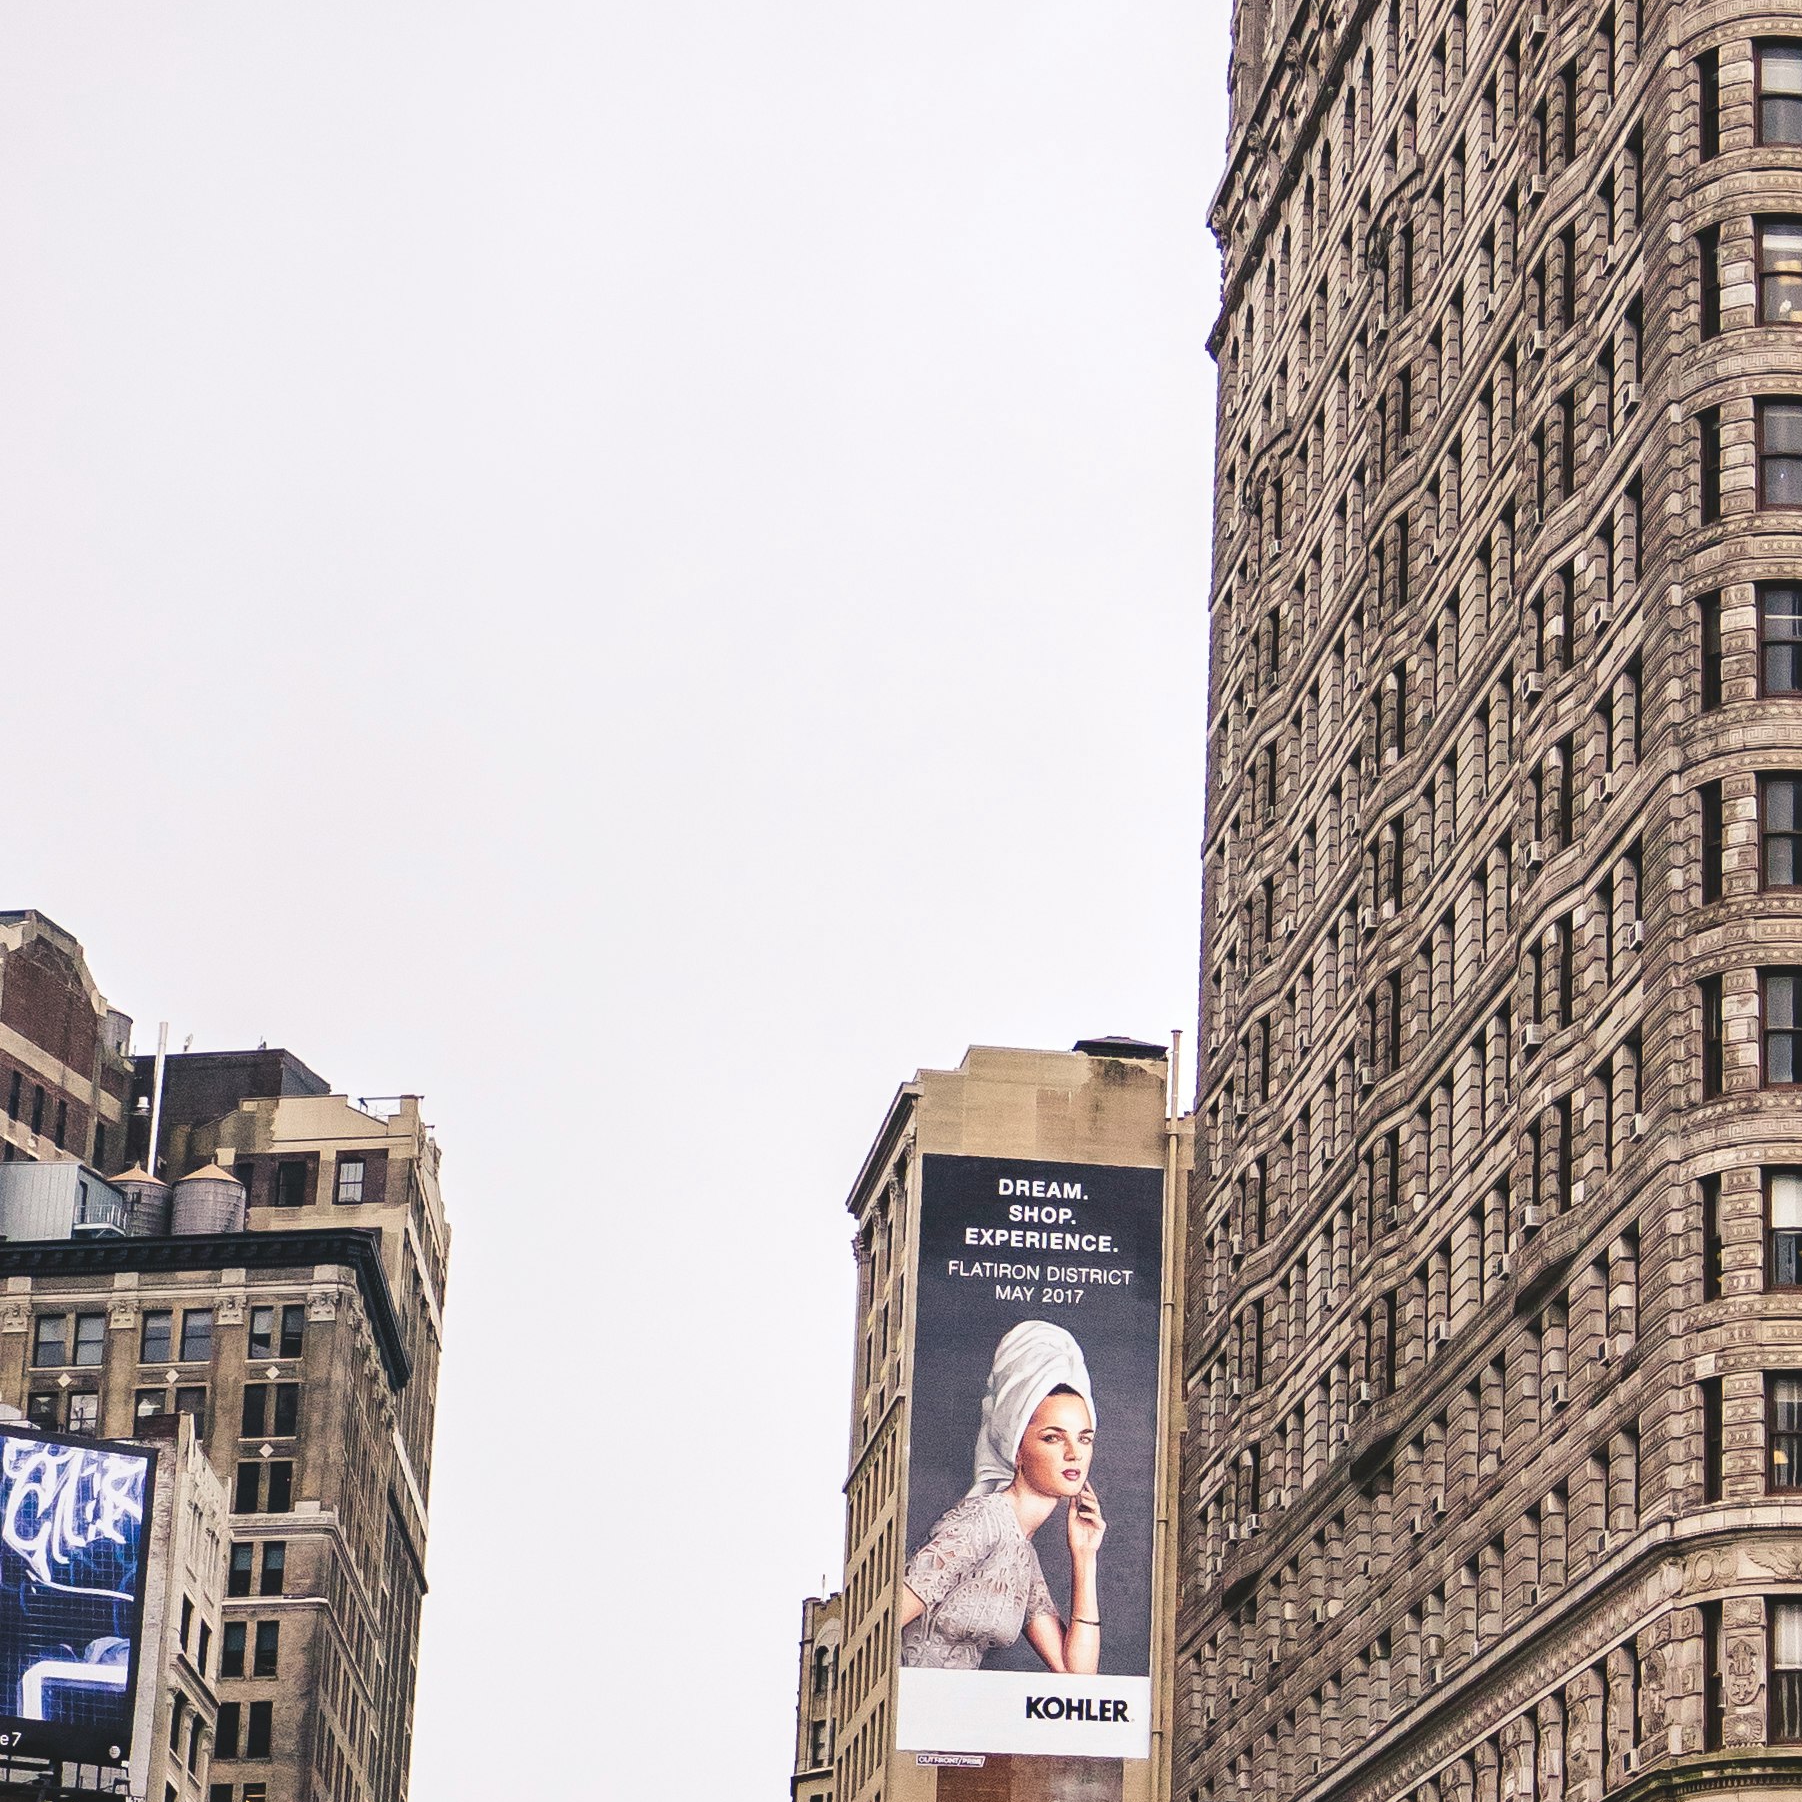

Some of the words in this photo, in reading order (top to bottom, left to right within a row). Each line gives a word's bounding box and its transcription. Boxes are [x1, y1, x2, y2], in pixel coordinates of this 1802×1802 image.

[998, 1178, 1089, 1200] DREAM.
[1008, 1204, 1077, 1225] SHOP.
[965, 1227, 1119, 1253] EXPERIENCE.
[948, 1260, 1040, 1281] FLATIRON
[1046, 1266, 1134, 1286] DISTRICT
[995, 1285, 1035, 1302] MAY
[1041, 1288, 1084, 1304] 2017
[1026, 1696, 1130, 1723] KOHLER
